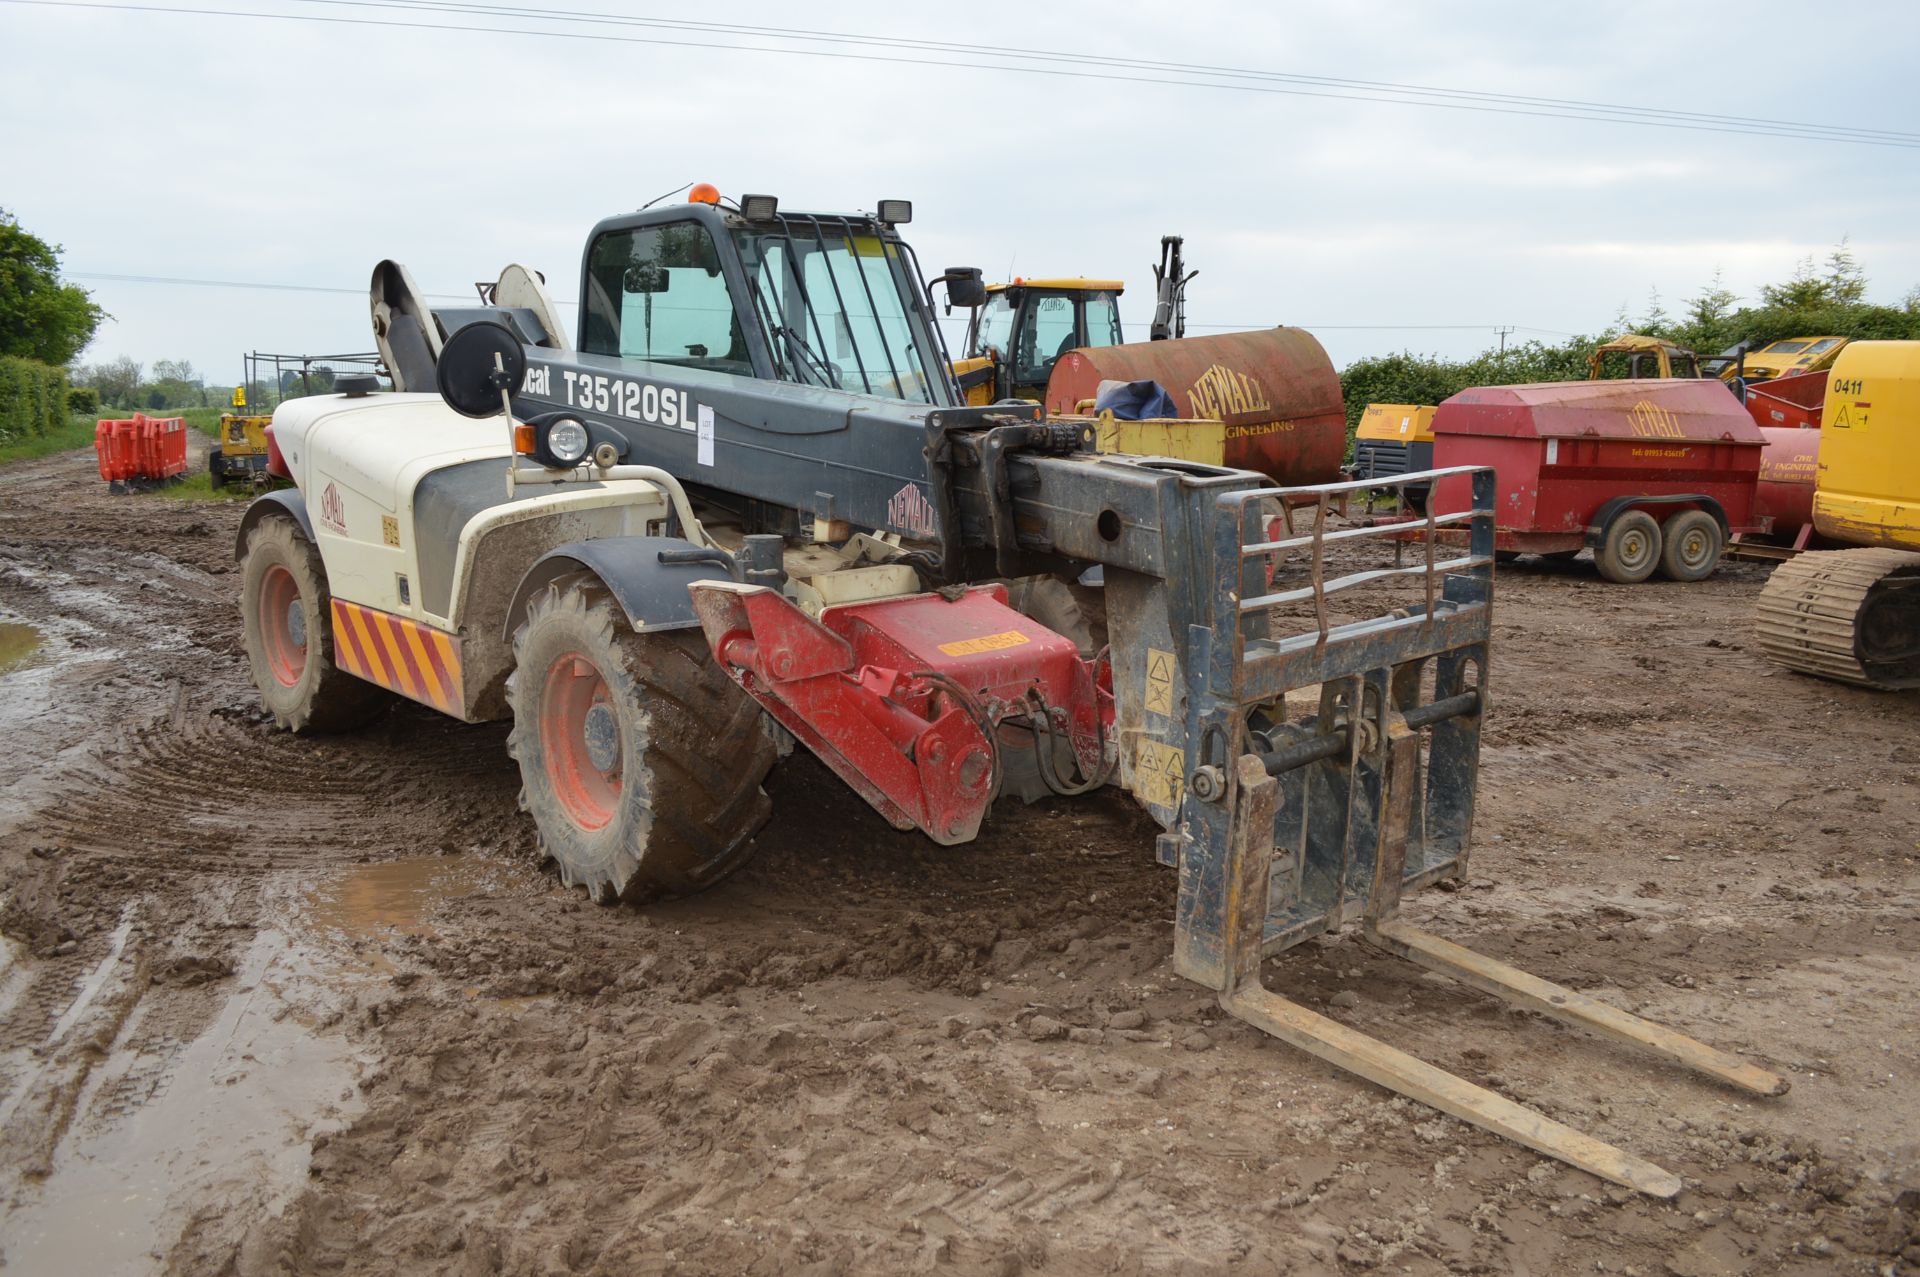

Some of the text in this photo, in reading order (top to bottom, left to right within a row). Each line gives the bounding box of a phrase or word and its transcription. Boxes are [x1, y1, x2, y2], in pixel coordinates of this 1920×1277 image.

[521, 365, 697, 431] cat T35120SL
[1187, 364, 1270, 418] NEWALL
[1834, 379, 1863, 395] 0411
[1225, 420, 1295, 438] GINEERING
[320, 480, 346, 528] NEWALL
[887, 481, 936, 537] NEWALL
